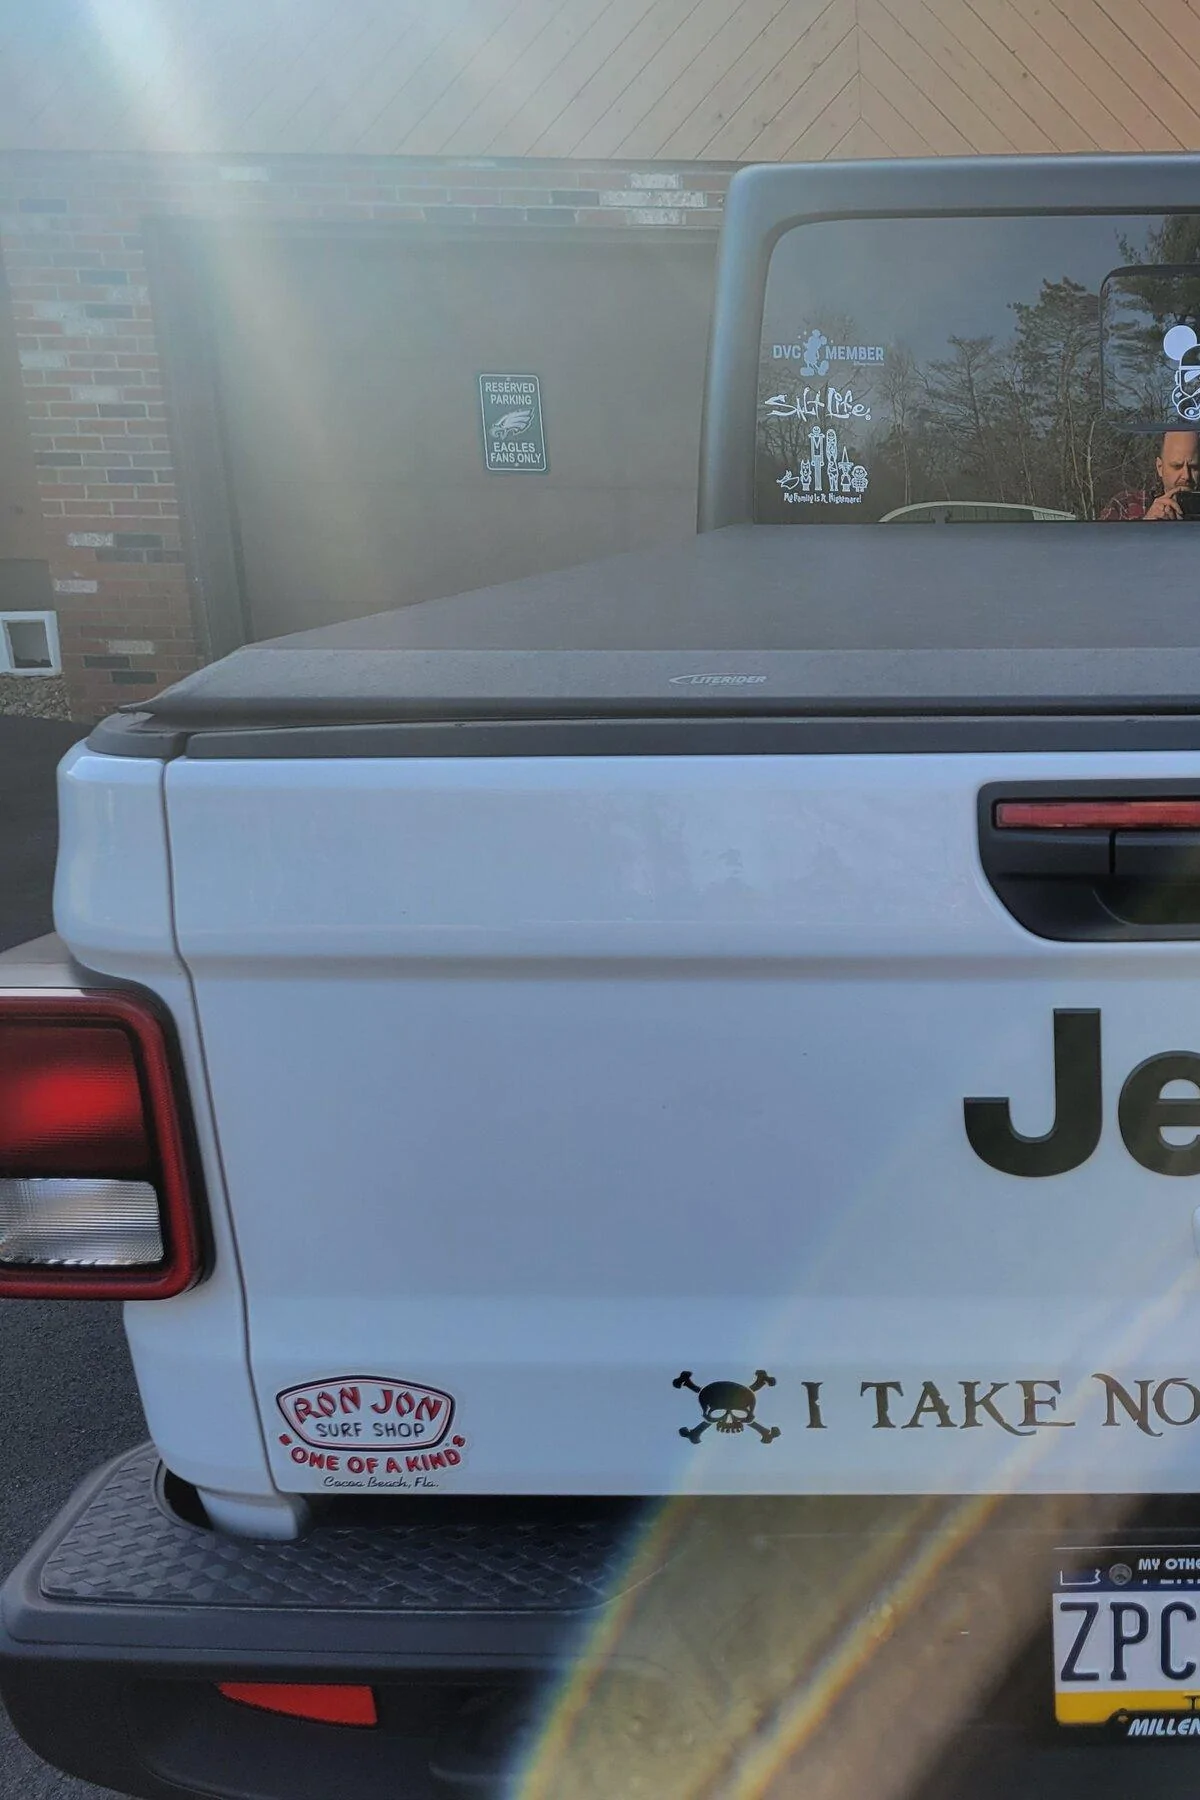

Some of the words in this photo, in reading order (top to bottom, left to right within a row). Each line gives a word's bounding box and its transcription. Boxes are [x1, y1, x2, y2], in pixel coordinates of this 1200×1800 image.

[772, 345, 801, 359] DVC
[825, 346, 884, 360] MEMBER
[485, 382, 535, 393] RESERVED
[490, 394, 532, 405] PARKING
[493, 442, 536, 453] EAGLES
[490, 452, 515, 463] FANS
[517, 453, 541, 463] ONLY
[690, 676, 767, 684] LITERIDER
[293, 1386, 361, 1424] RON
[370, 1389, 443, 1422] JON
[800, 1380, 828, 1429] I
[860, 1378, 1077, 1437] TAKE
[315, 1422, 364, 1437] SURF
[373, 1422, 425, 1437] SHOP
[291, 1447, 341, 1471] ONE
[347, 1455, 380, 1475] OF
[386, 1456, 403, 1474] A
[405, 1448, 462, 1473] KIND
[323, 1475, 366, 1488] Cocoa
[1138, 1557, 1161, 1572] MY
